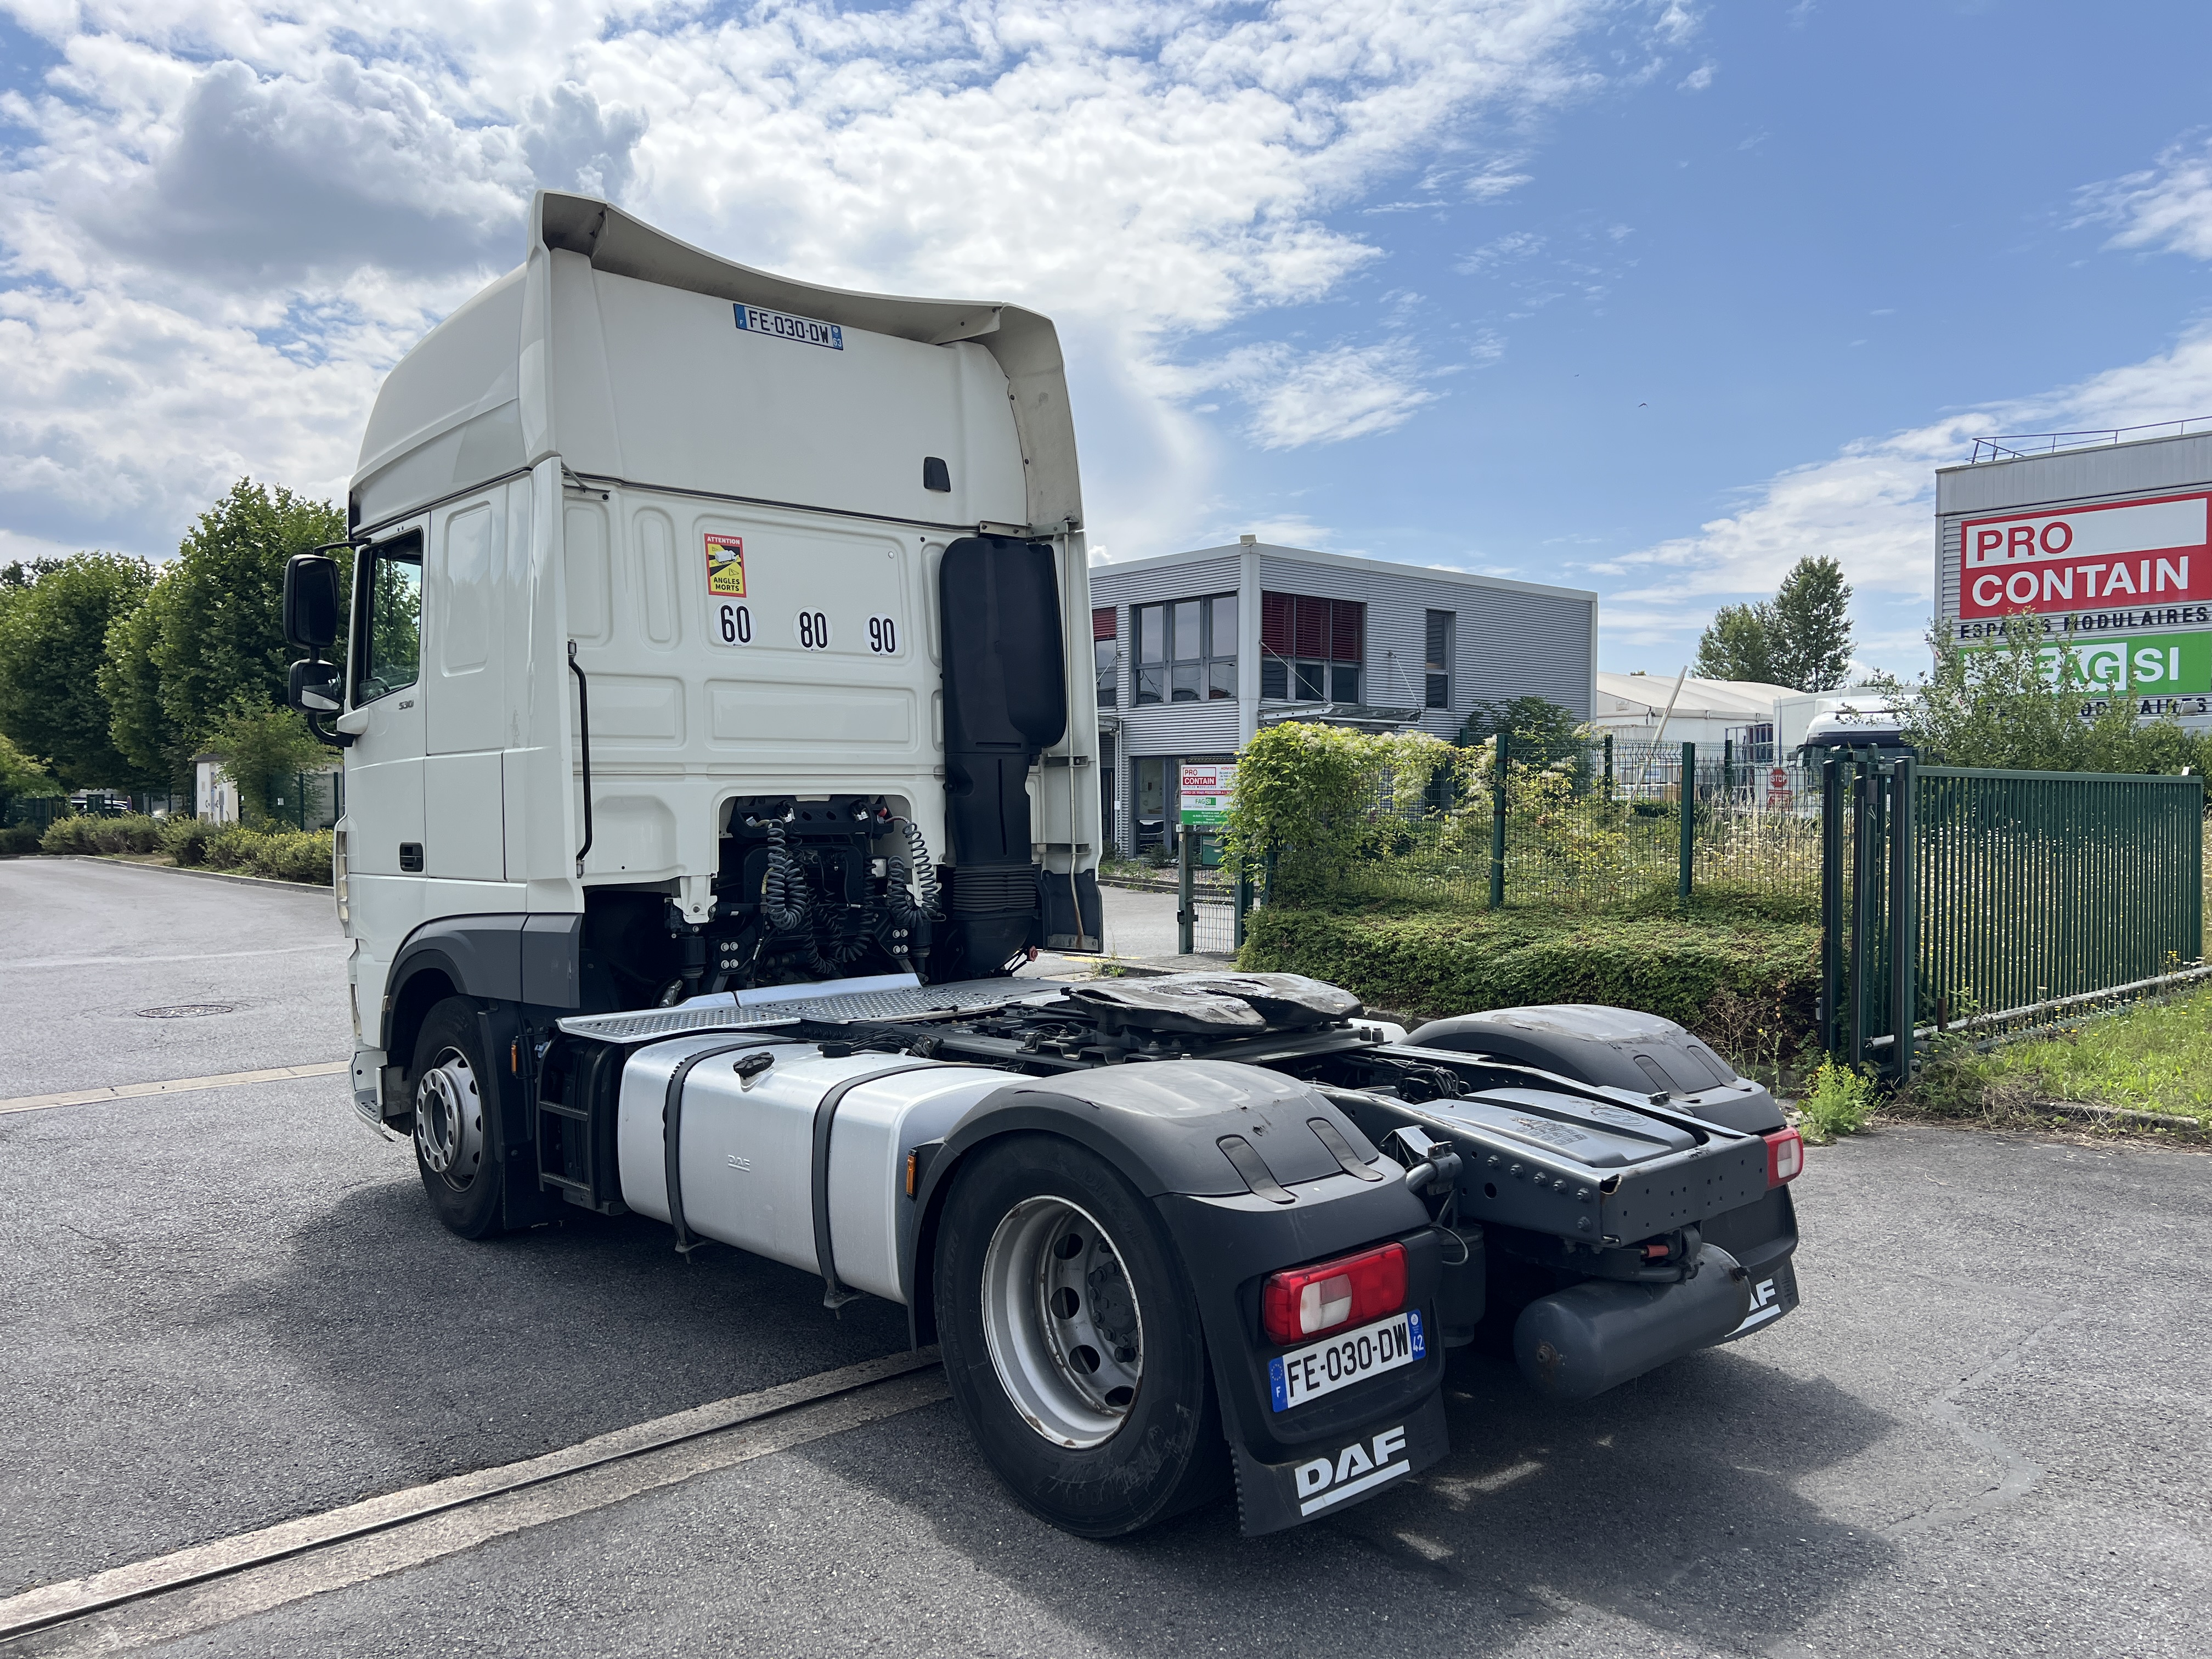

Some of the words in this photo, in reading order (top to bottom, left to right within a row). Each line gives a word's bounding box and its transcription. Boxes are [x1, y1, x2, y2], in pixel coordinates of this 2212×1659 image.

[748, 309, 828, 344] FE-030-DW
[833, 337, 842, 347] 63
[707, 536, 740, 545] ATTENTION
[1977, 521, 2073, 561] PRO
[714, 577, 740, 585] ANGLES
[1972, 556, 2189, 607] CONTAIN
[720, 605, 751, 643] 60
[799, 611, 828, 648] 80
[869, 617, 896, 653] 90
[2064, 606, 2208, 632] MODULAIRES
[727, 1154, 751, 1167] DAF
[1276, 1386, 1281, 1398] F
[1287, 1322, 1408, 1398] FE-030-DW
[1413, 1334, 1424, 1352] 42
[1294, 1425, 1406, 1499] DAF
